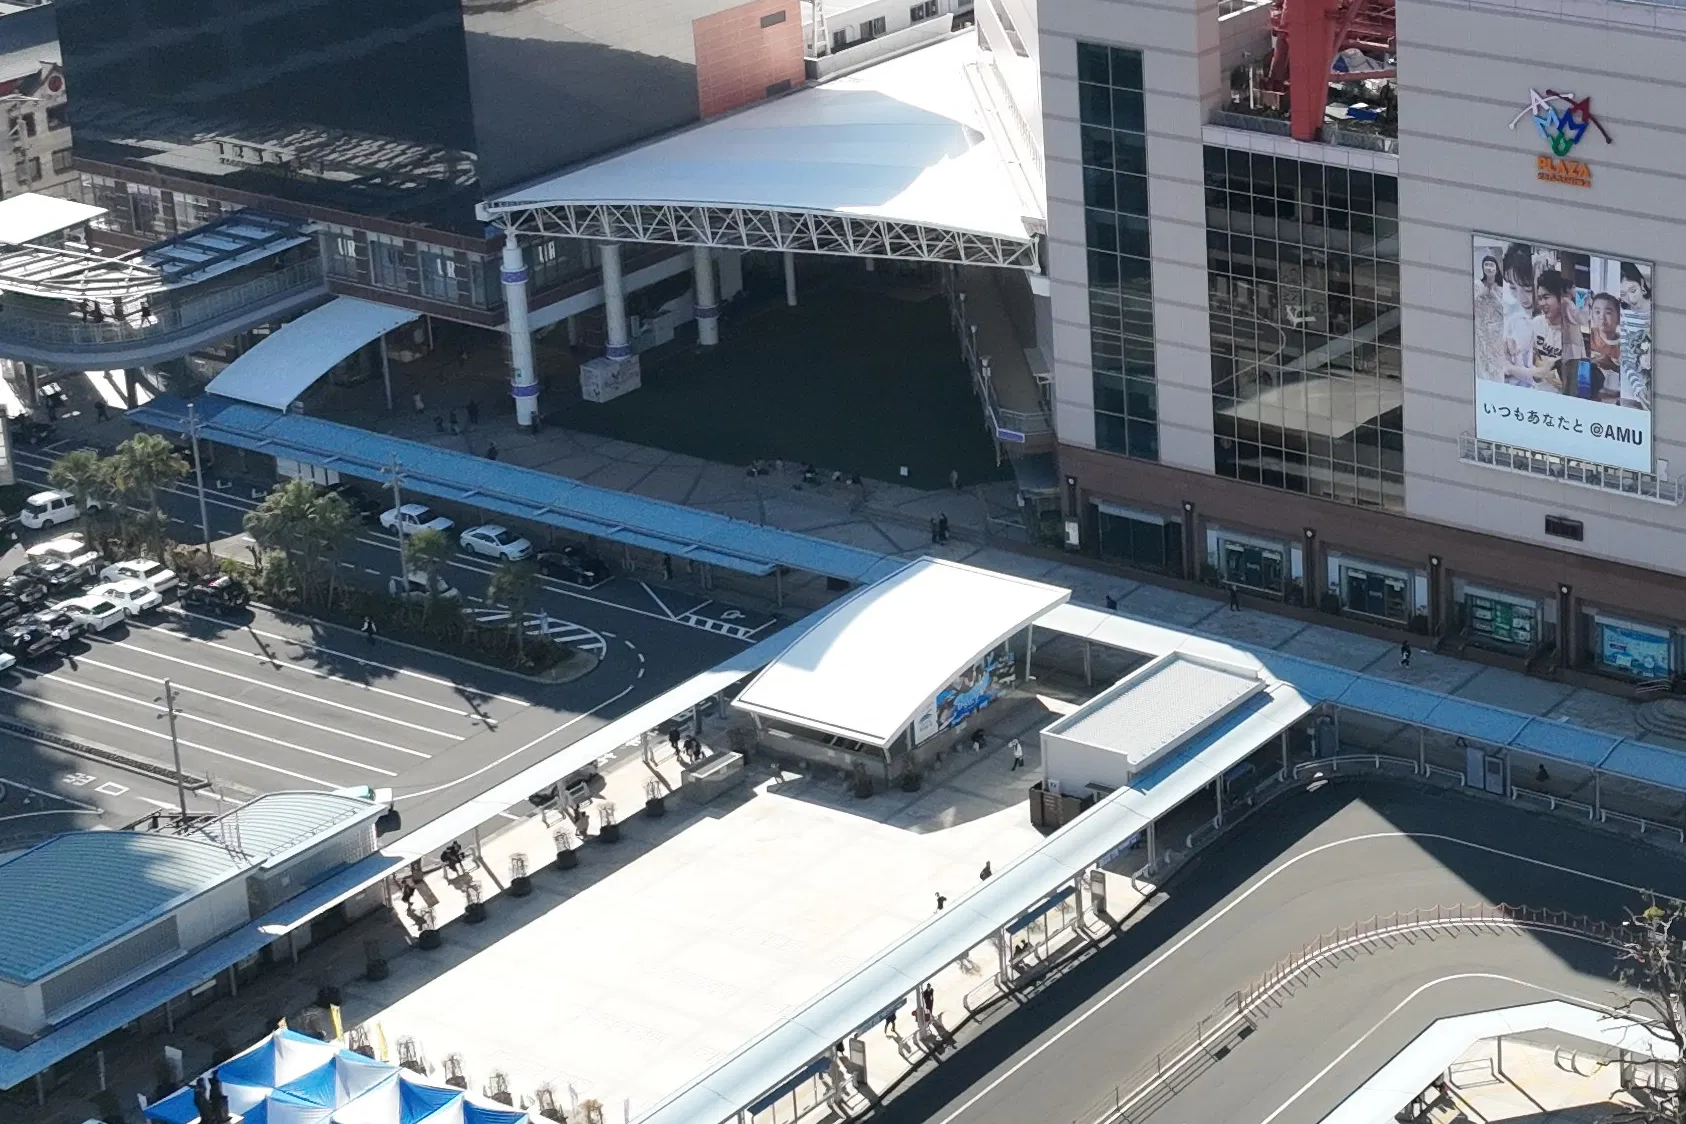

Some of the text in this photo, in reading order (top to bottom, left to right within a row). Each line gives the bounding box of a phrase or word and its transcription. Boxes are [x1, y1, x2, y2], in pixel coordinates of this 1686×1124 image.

[1537, 155, 1591, 178] PLAZA
[1483, 402, 1643, 446] いつもあなたと @AMU
